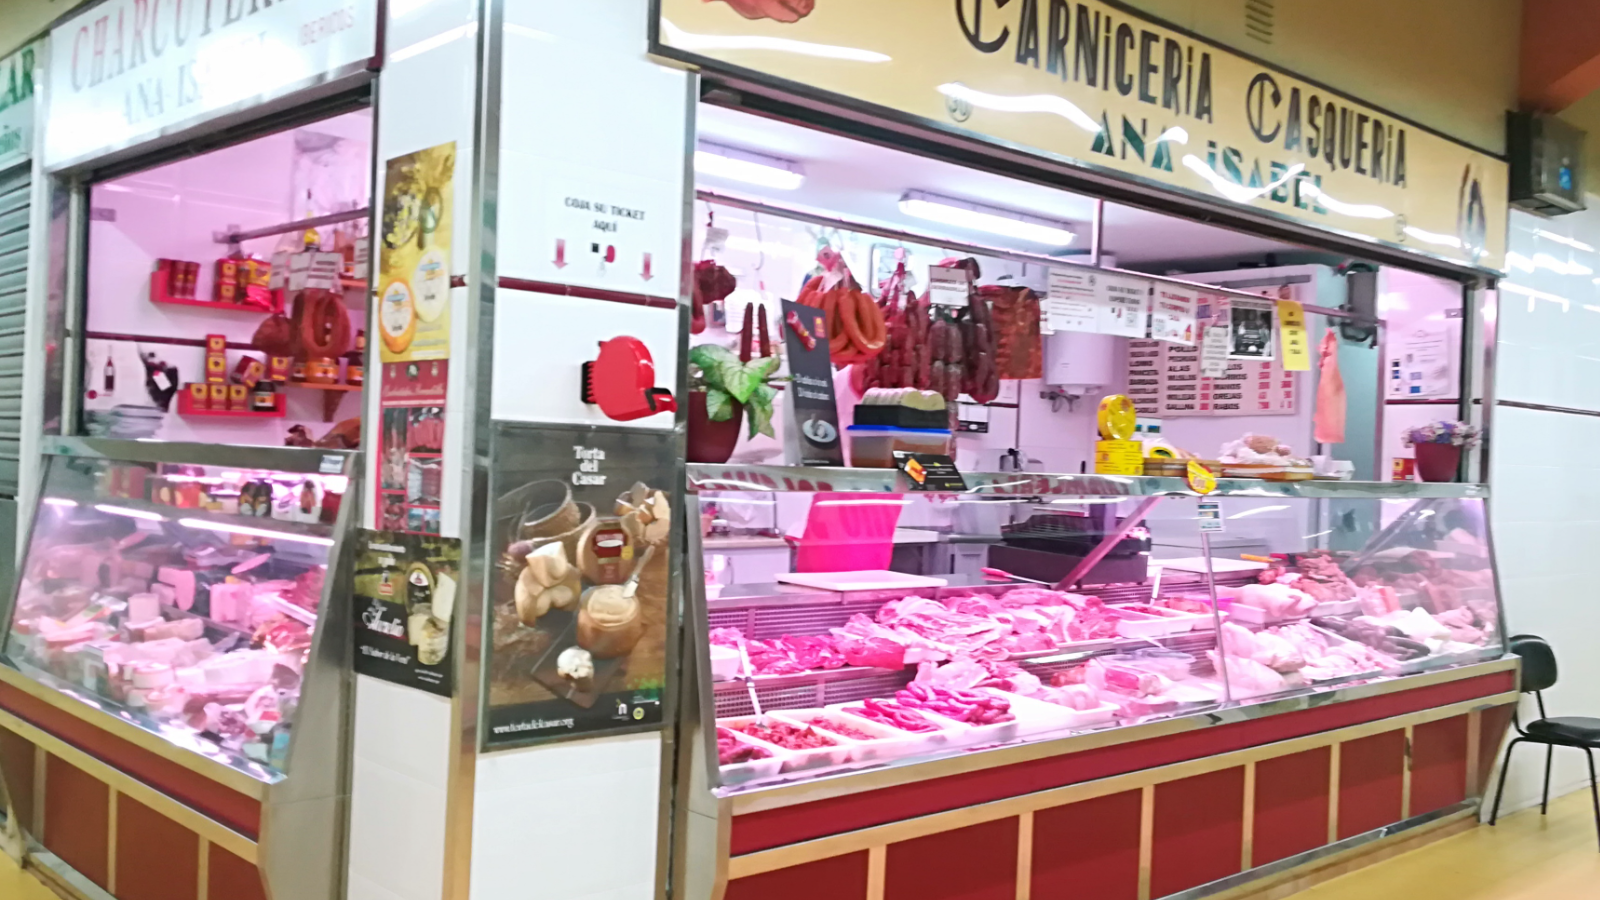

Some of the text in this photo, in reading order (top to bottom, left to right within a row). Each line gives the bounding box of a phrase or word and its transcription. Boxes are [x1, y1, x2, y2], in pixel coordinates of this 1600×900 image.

[1090, 110, 1173, 173] ANA
[610, 205, 646, 221] TICKET
[573, 445, 606, 460] Torta
[579, 459, 598, 472] del
[571, 471, 607, 485] Casar
